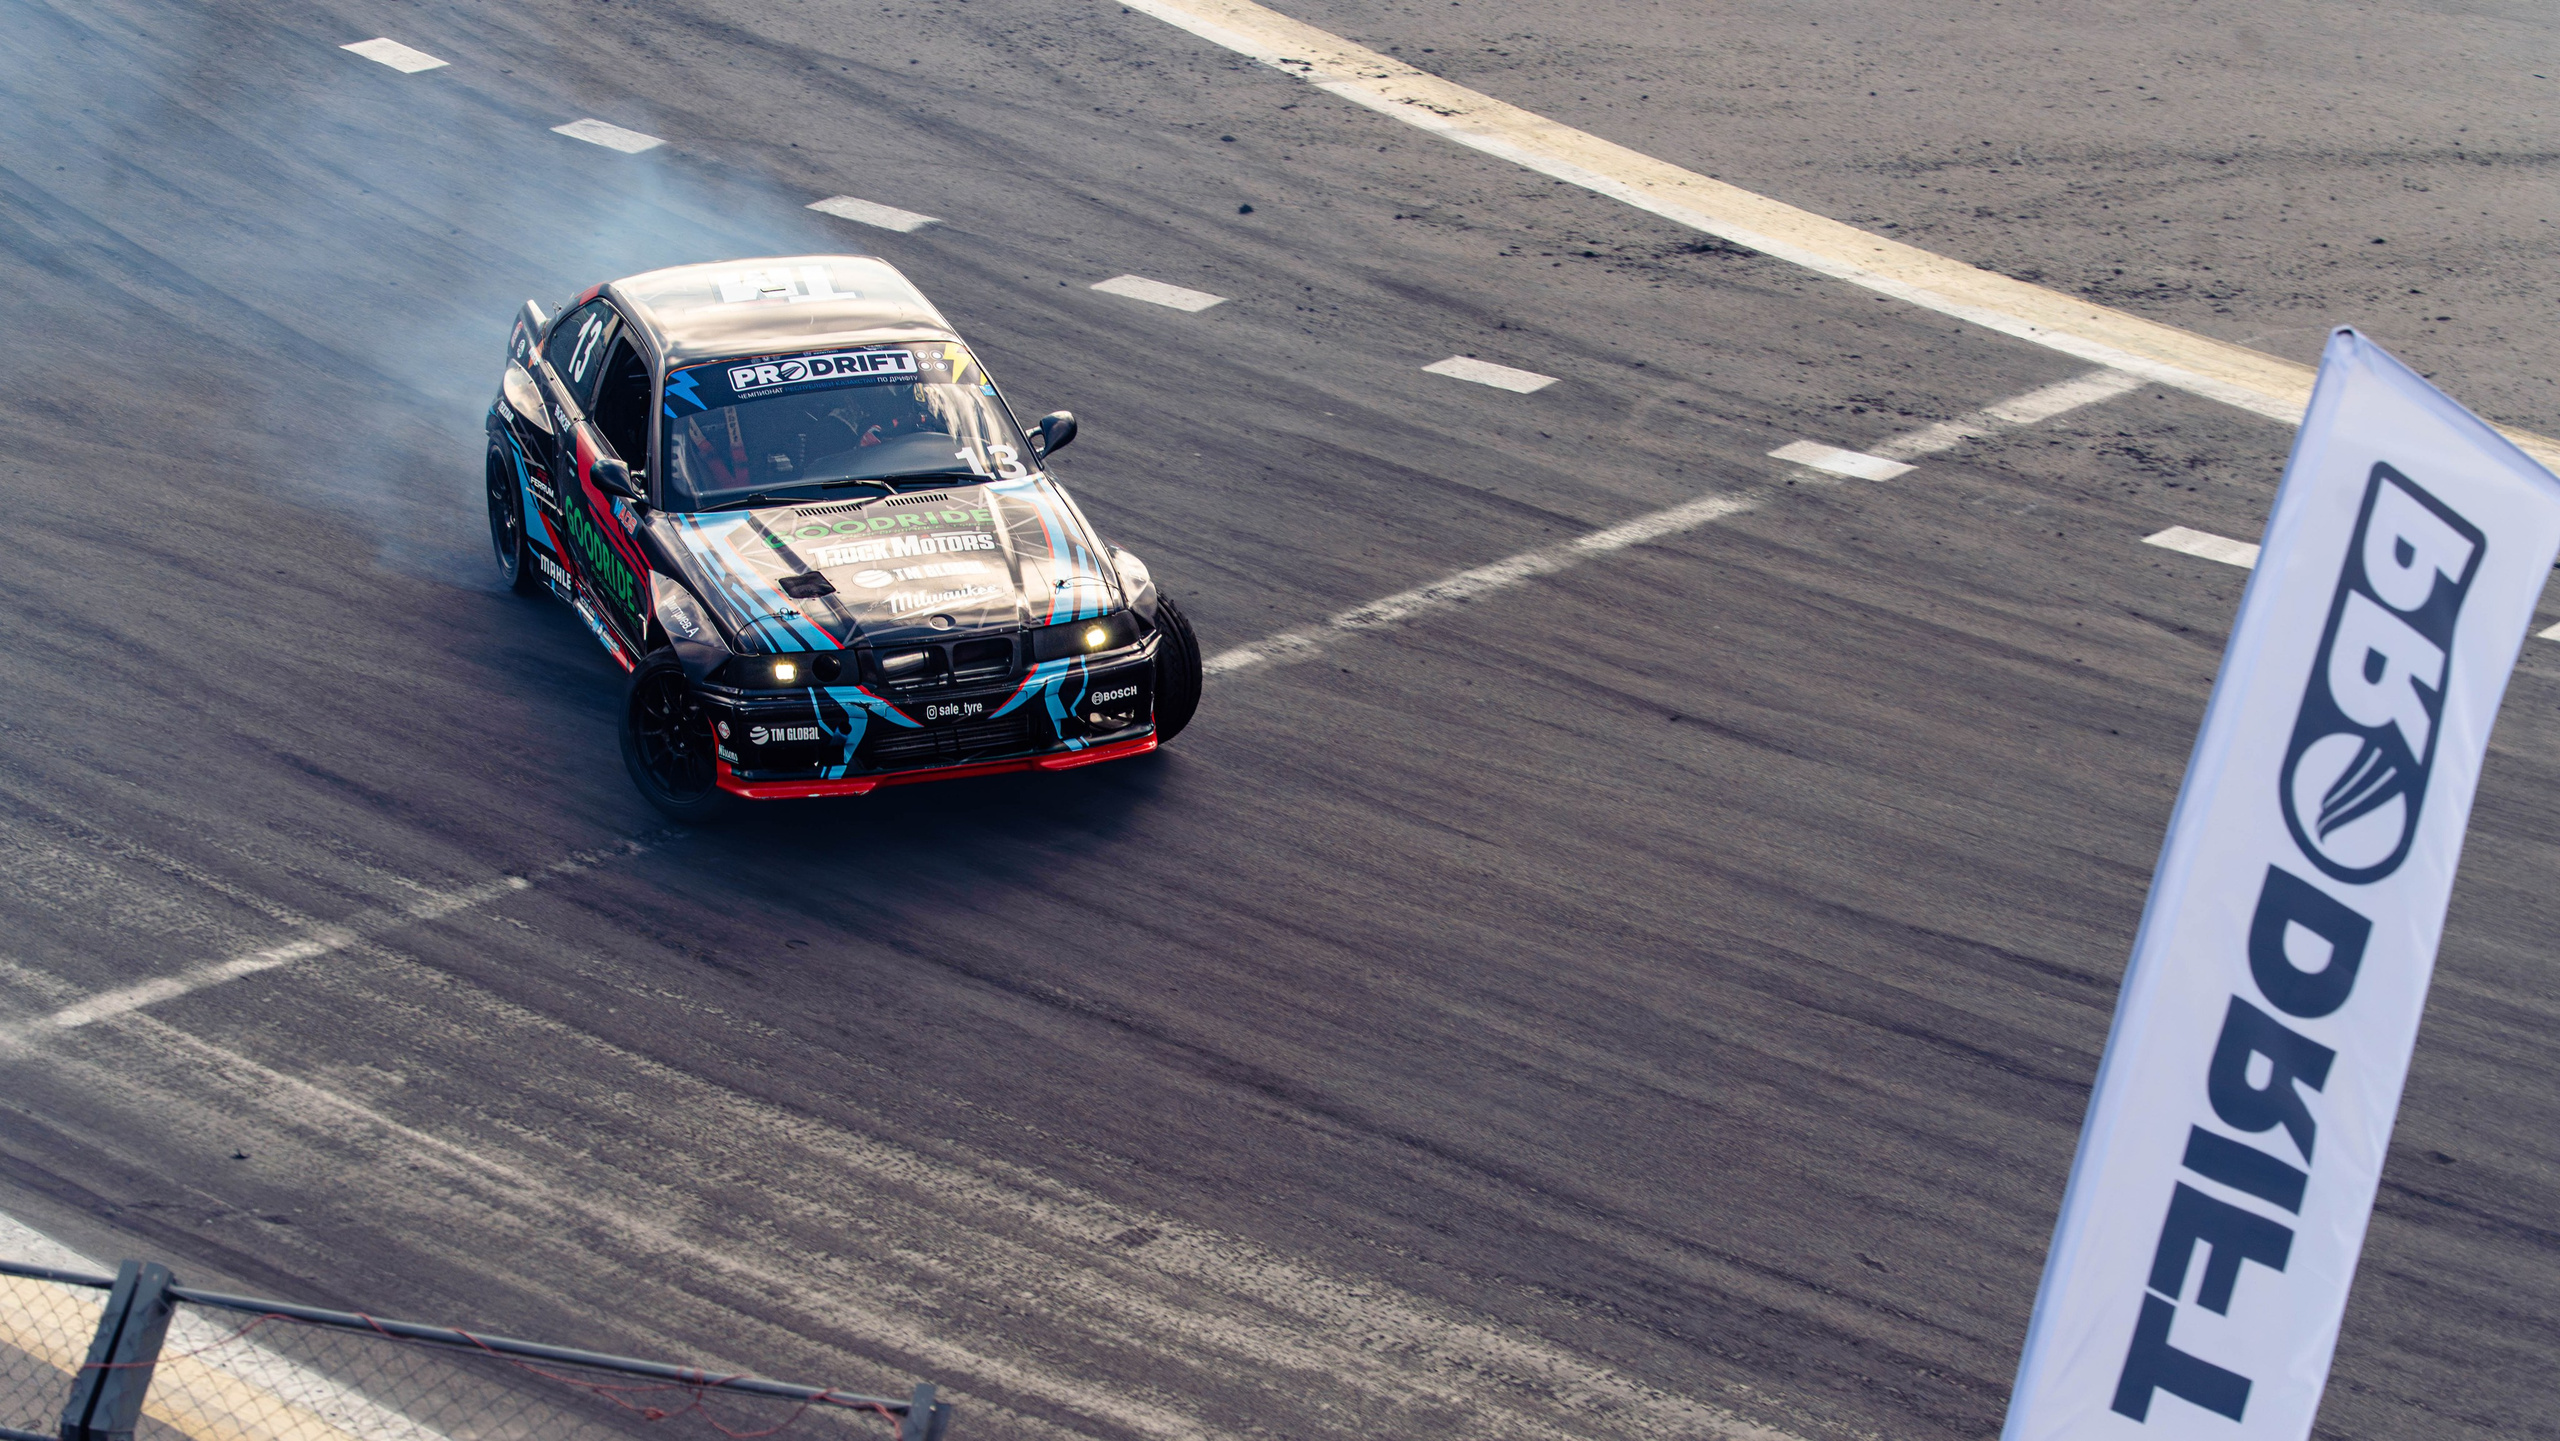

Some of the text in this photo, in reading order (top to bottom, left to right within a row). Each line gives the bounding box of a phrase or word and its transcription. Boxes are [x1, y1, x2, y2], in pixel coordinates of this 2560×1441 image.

[568, 312, 603, 384] 13
[732, 353, 909, 389] PRODRIFT
[737, 387, 784, 400] ЧЕМПИОНАТ
[889, 375, 918, 384] ДРИФТУ
[954, 444, 1028, 480] 13
[530, 475, 555, 498] FERRUM
[762, 508, 995, 549] GOODRIDE
[565, 495, 635, 612] GOODRIDE
[806, 532, 997, 570] TRUCK MOTORS
[540, 553, 572, 591] MAHLE
[893, 566, 924, 582] TM
[882, 583, 998, 614] Milwaukee
[939, 702, 983, 717] sale_tyre
[1103, 685, 1138, 702] BOSCH
[770, 728, 785, 742] TM
